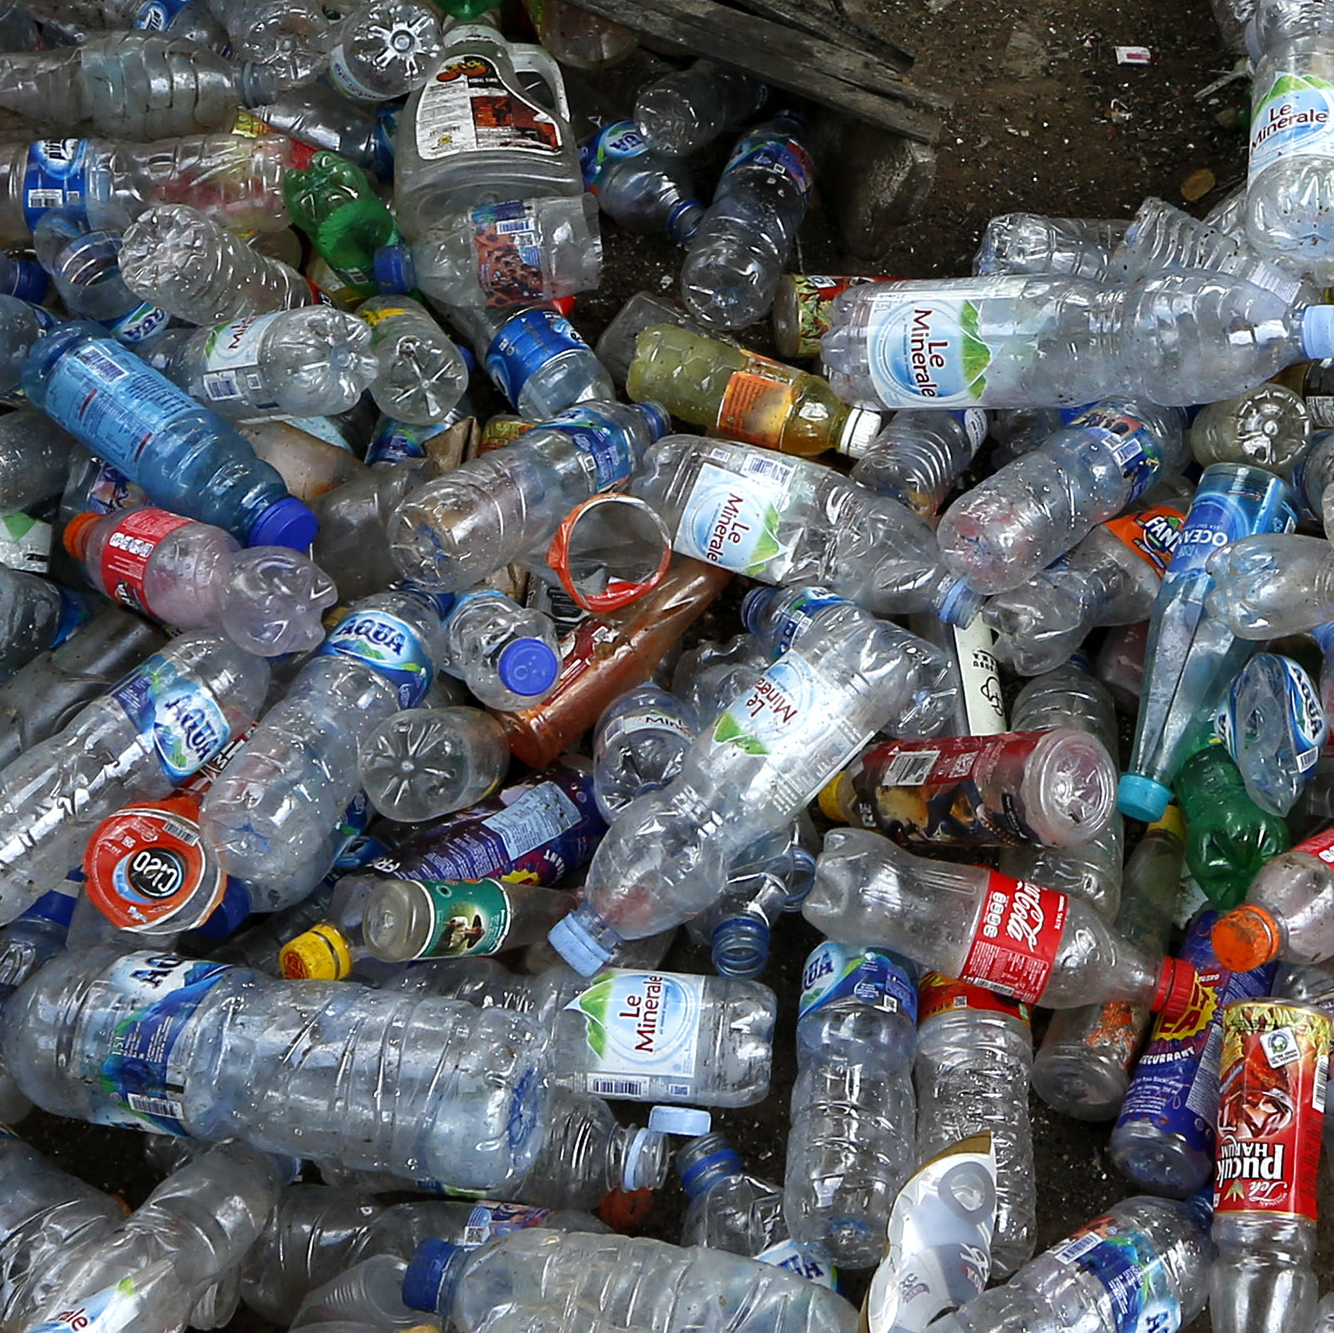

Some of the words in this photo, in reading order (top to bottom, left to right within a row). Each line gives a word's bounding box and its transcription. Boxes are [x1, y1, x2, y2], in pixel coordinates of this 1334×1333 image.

[1250, 110, 1329, 152] Minerale
[1270, 103, 1293, 123] Le
[912, 307, 939, 399] Minerale
[927, 340, 946, 369] Le
[705, 492, 744, 564] Minerale
[727, 524, 750, 544] Le
[335, 618, 408, 657] AQUA
[746, 694, 766, 718] Le
[1292, 668, 1321, 740] AQUA
[165, 694, 221, 762] AQUA
[619, 994, 643, 1018] Le
[634, 974, 663, 1054] Minerale
[1220, 1135, 1265, 1159] HARUM
